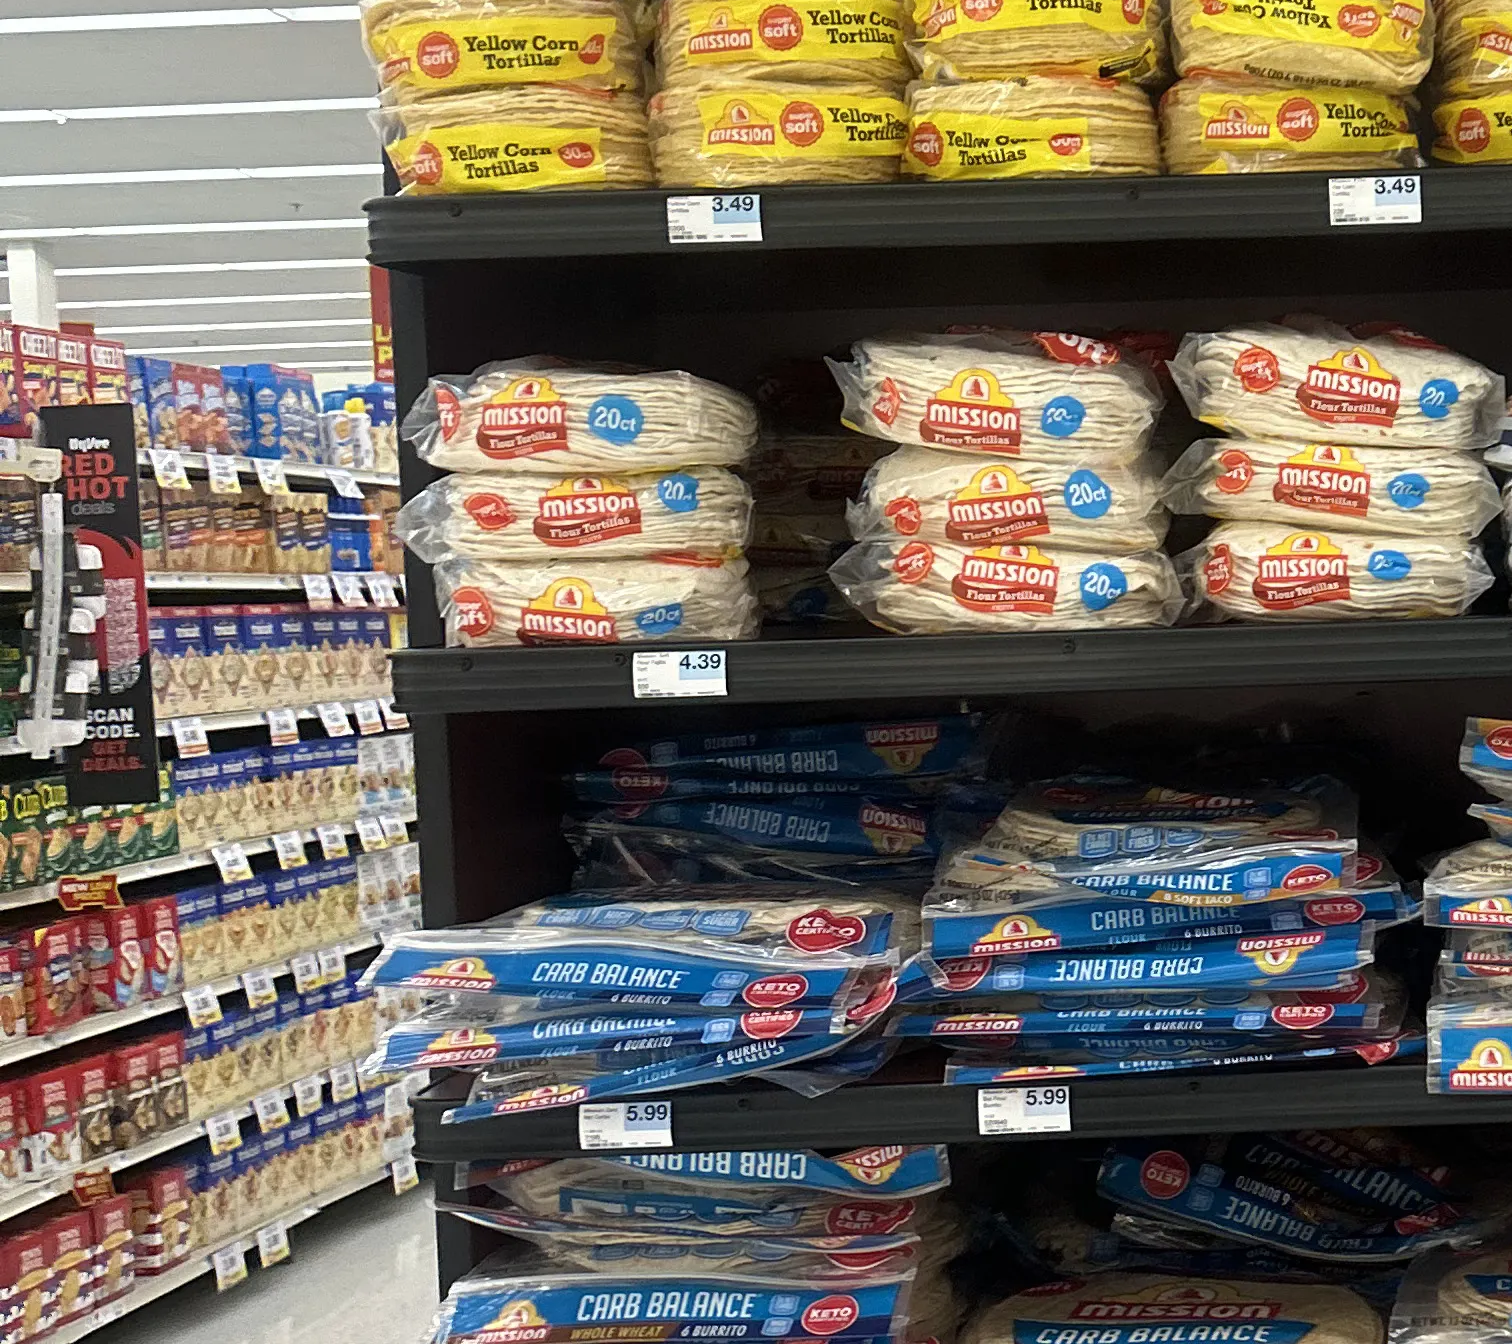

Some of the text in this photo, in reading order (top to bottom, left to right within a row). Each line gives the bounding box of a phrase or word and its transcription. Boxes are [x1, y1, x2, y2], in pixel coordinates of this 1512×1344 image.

[807, 11, 865, 28] Yellow
[464, 35, 579, 52] Yellow Corn
[1374, 179, 1416, 195] 3.49
[711, 196, 754, 213] 3.49
[594, 407, 637, 432] 20ct
[63, 455, 114, 478] RED
[67, 477, 128, 500] HOT
[71, 502, 117, 516] deals
[679, 654, 721, 670] 4.39
[85, 725, 140, 739] CODE.
[532, 962, 691, 990] CARB BALANCE
[1026, 1089, 1066, 1107] 5.99
[626, 1105, 668, 1122] 5.99
[577, 1293, 756, 1321] CARB BALANCE
[570, 1325, 663, 1339] WHOLE WHEAT
[1131, 1324, 1274, 1343] BALANCE
